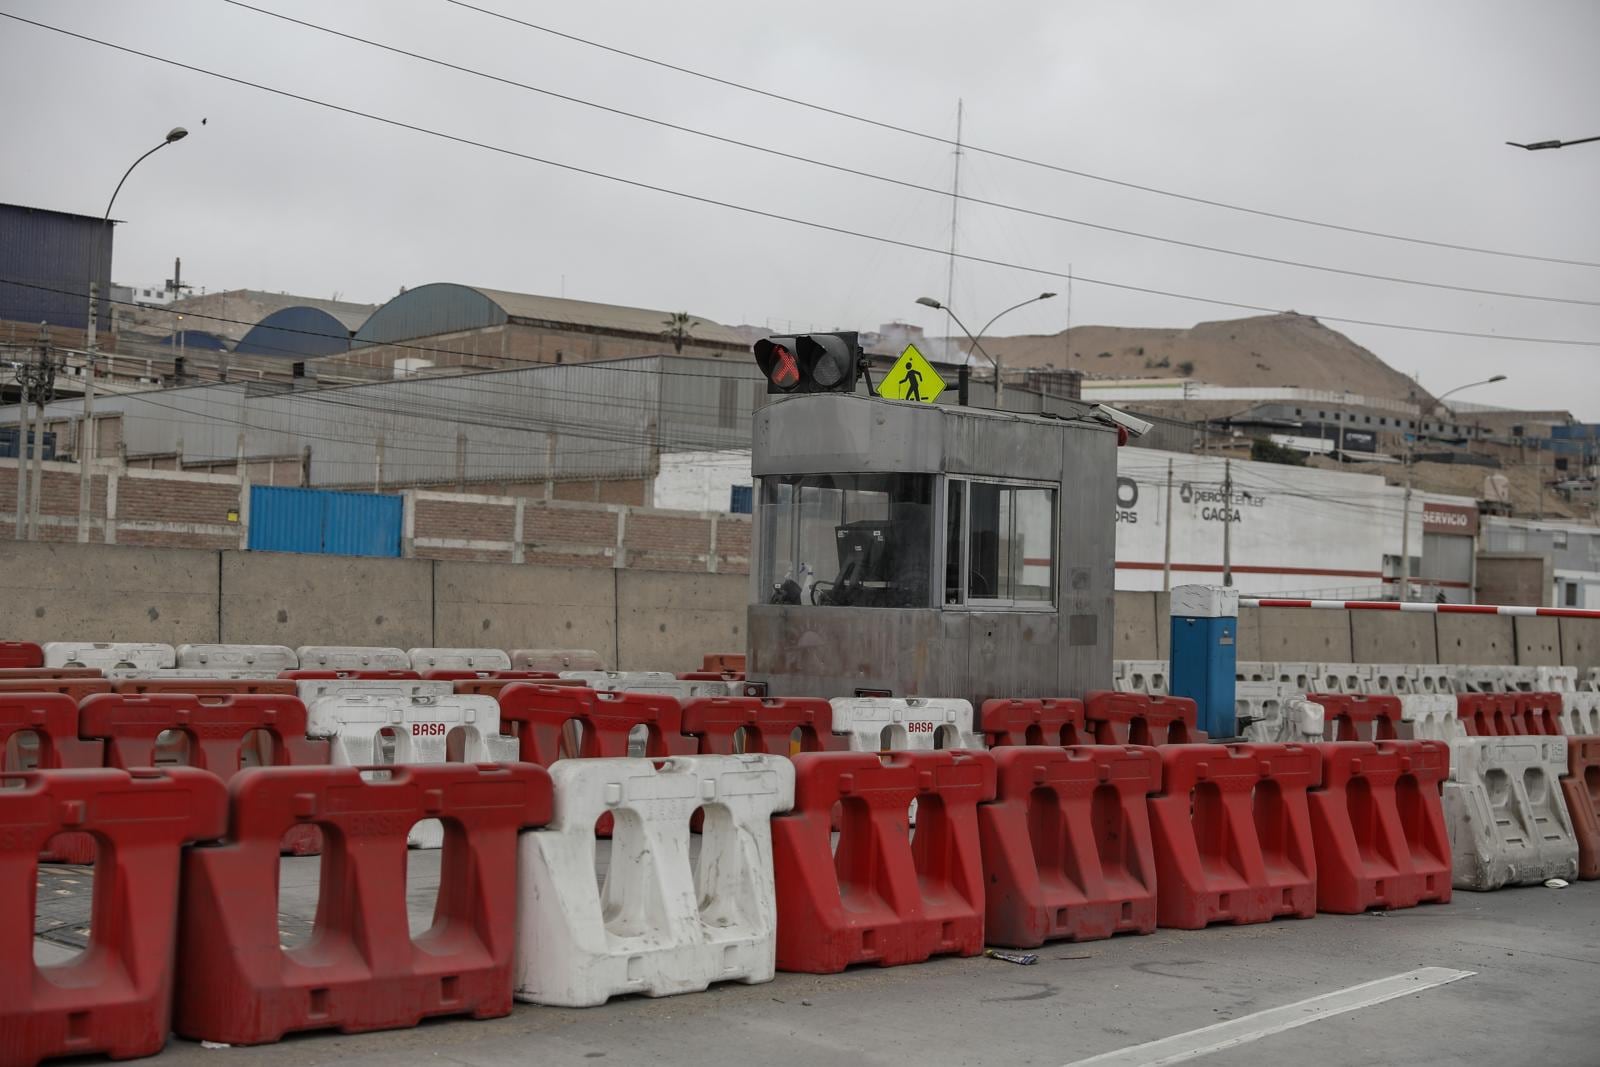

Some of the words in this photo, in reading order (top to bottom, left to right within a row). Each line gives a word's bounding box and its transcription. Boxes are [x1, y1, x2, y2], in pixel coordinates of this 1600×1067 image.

[1423, 511, 1468, 527] SERVICIO
[412, 723, 446, 736] BASA
[908, 722, 933, 733] BASA
